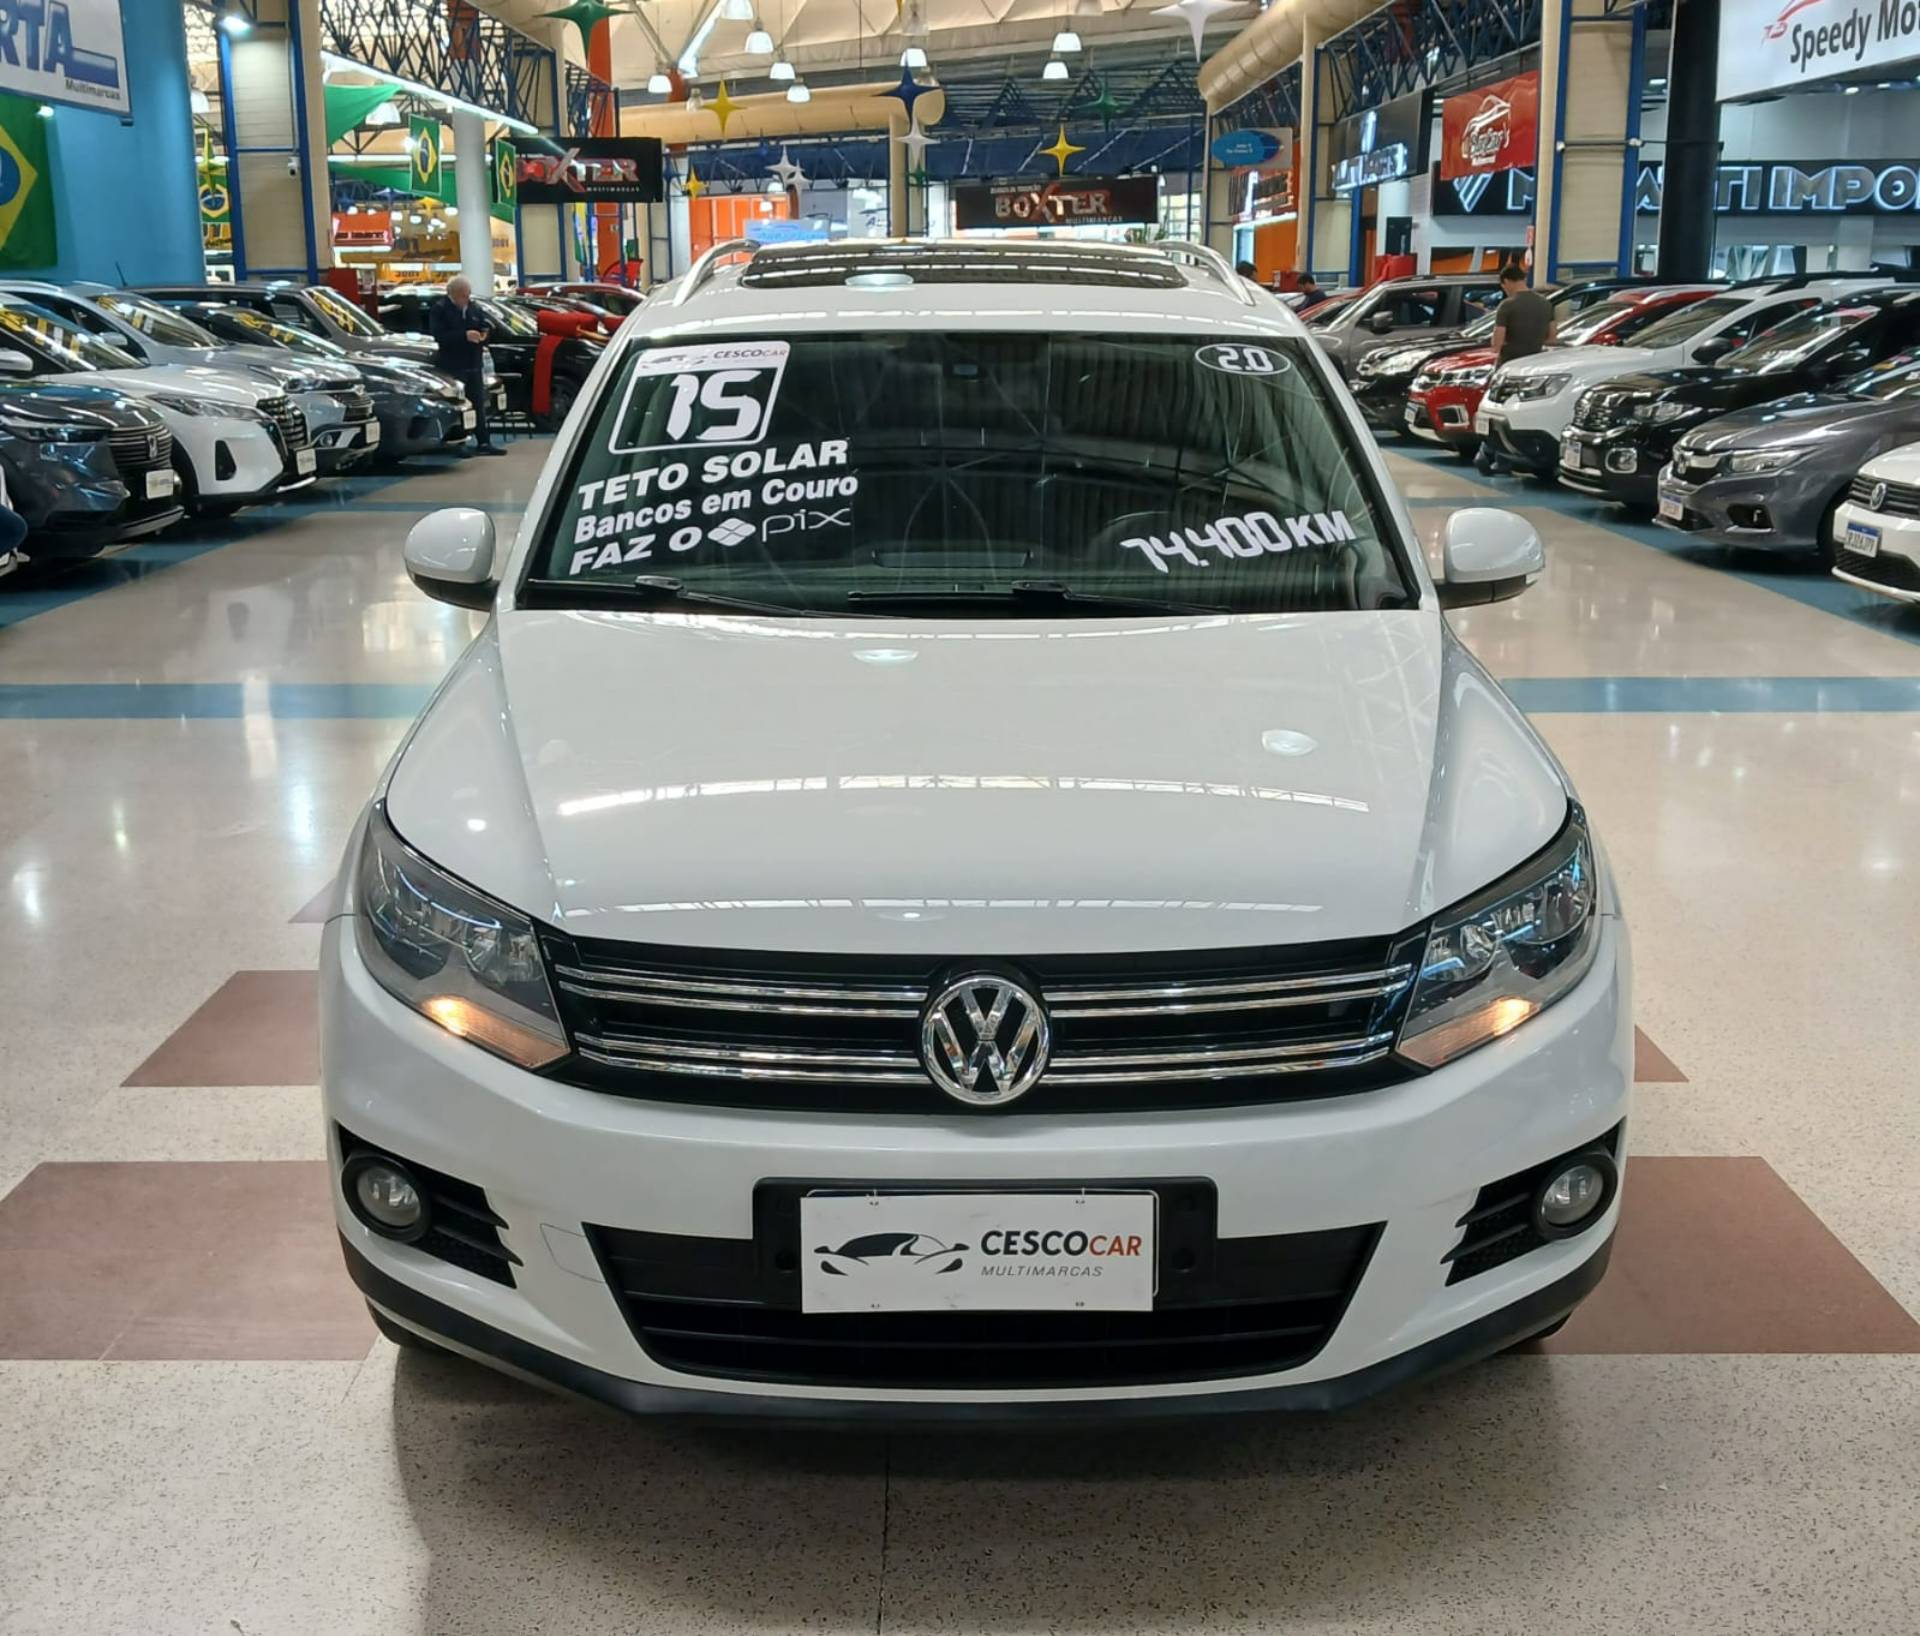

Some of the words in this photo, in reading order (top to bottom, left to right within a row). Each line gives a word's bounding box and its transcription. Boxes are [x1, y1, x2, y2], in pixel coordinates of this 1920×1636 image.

[1790, 8, 1873, 73] Speedy
[1876, 0, 1920, 42] Mo
[995, 182, 1112, 224] BOXTER
[1768, 165, 1920, 211] IMPO
[713, 349, 787, 360] CESCOCAR
[1215, 346, 1274, 372] 2.0
[666, 370, 762, 441] 15
[578, 462, 689, 511] TETO
[701, 439, 849, 484] SOLAR
[573, 498, 692, 544] Bancos
[701, 488, 752, 515] em
[761, 475, 859, 505] Couro
[568, 533, 656, 576] FAZ
[668, 525, 703, 552] O
[979, 1230, 1143, 1257] CESCOCAR
[980, 1265, 1104, 1278] MULTIMARCAS
